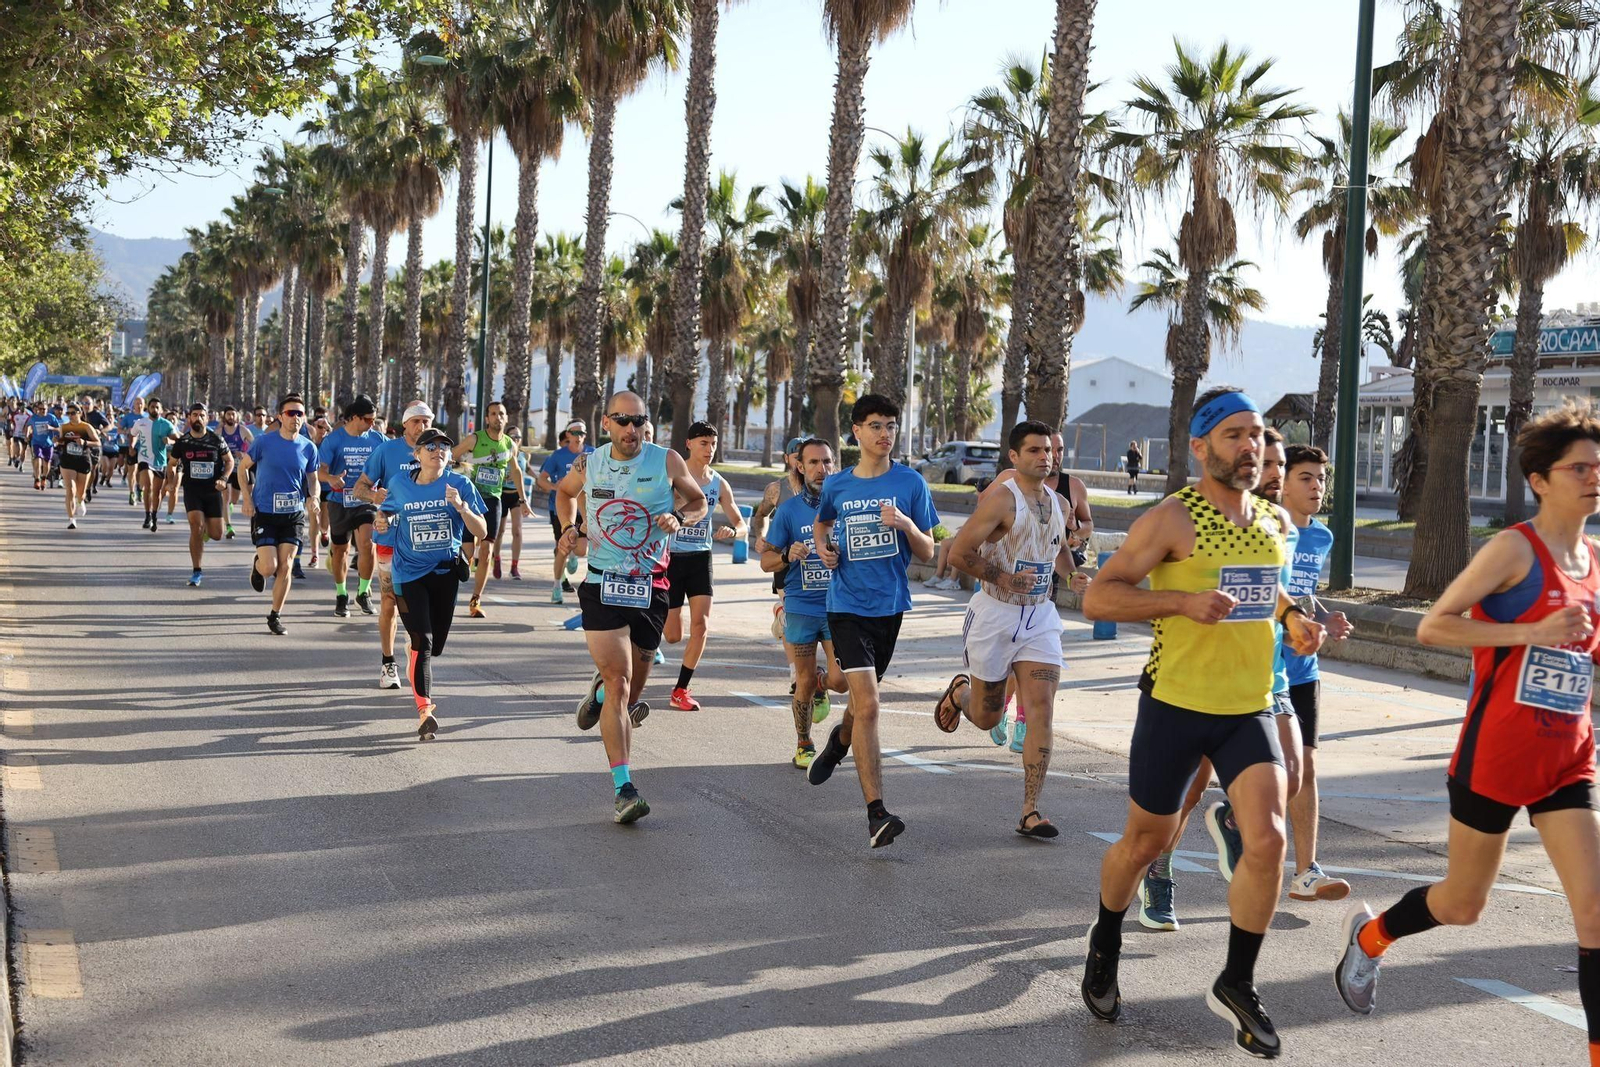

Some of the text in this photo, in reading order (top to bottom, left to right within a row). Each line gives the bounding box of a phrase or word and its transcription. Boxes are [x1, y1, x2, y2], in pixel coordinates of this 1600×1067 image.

[1540, 328, 1600, 352] ROCAM
[1542, 377, 1580, 386] ROCAMAR
[343, 446, 373, 454] mayoral
[278, 499, 298, 507] 1817
[404, 497, 448, 511] mayoral
[842, 496, 897, 511] mayoral
[416, 530, 448, 541] 1773
[681, 527, 706, 537] 1696
[852, 532, 892, 548] 2210
[1294, 551, 1324, 565] yoral
[806, 570, 832, 580] 204
[1037, 574, 1049, 585] 84
[608, 583, 646, 596] 1669
[1227, 586, 1273, 602] 2053
[1531, 668, 1588, 694] 2112
